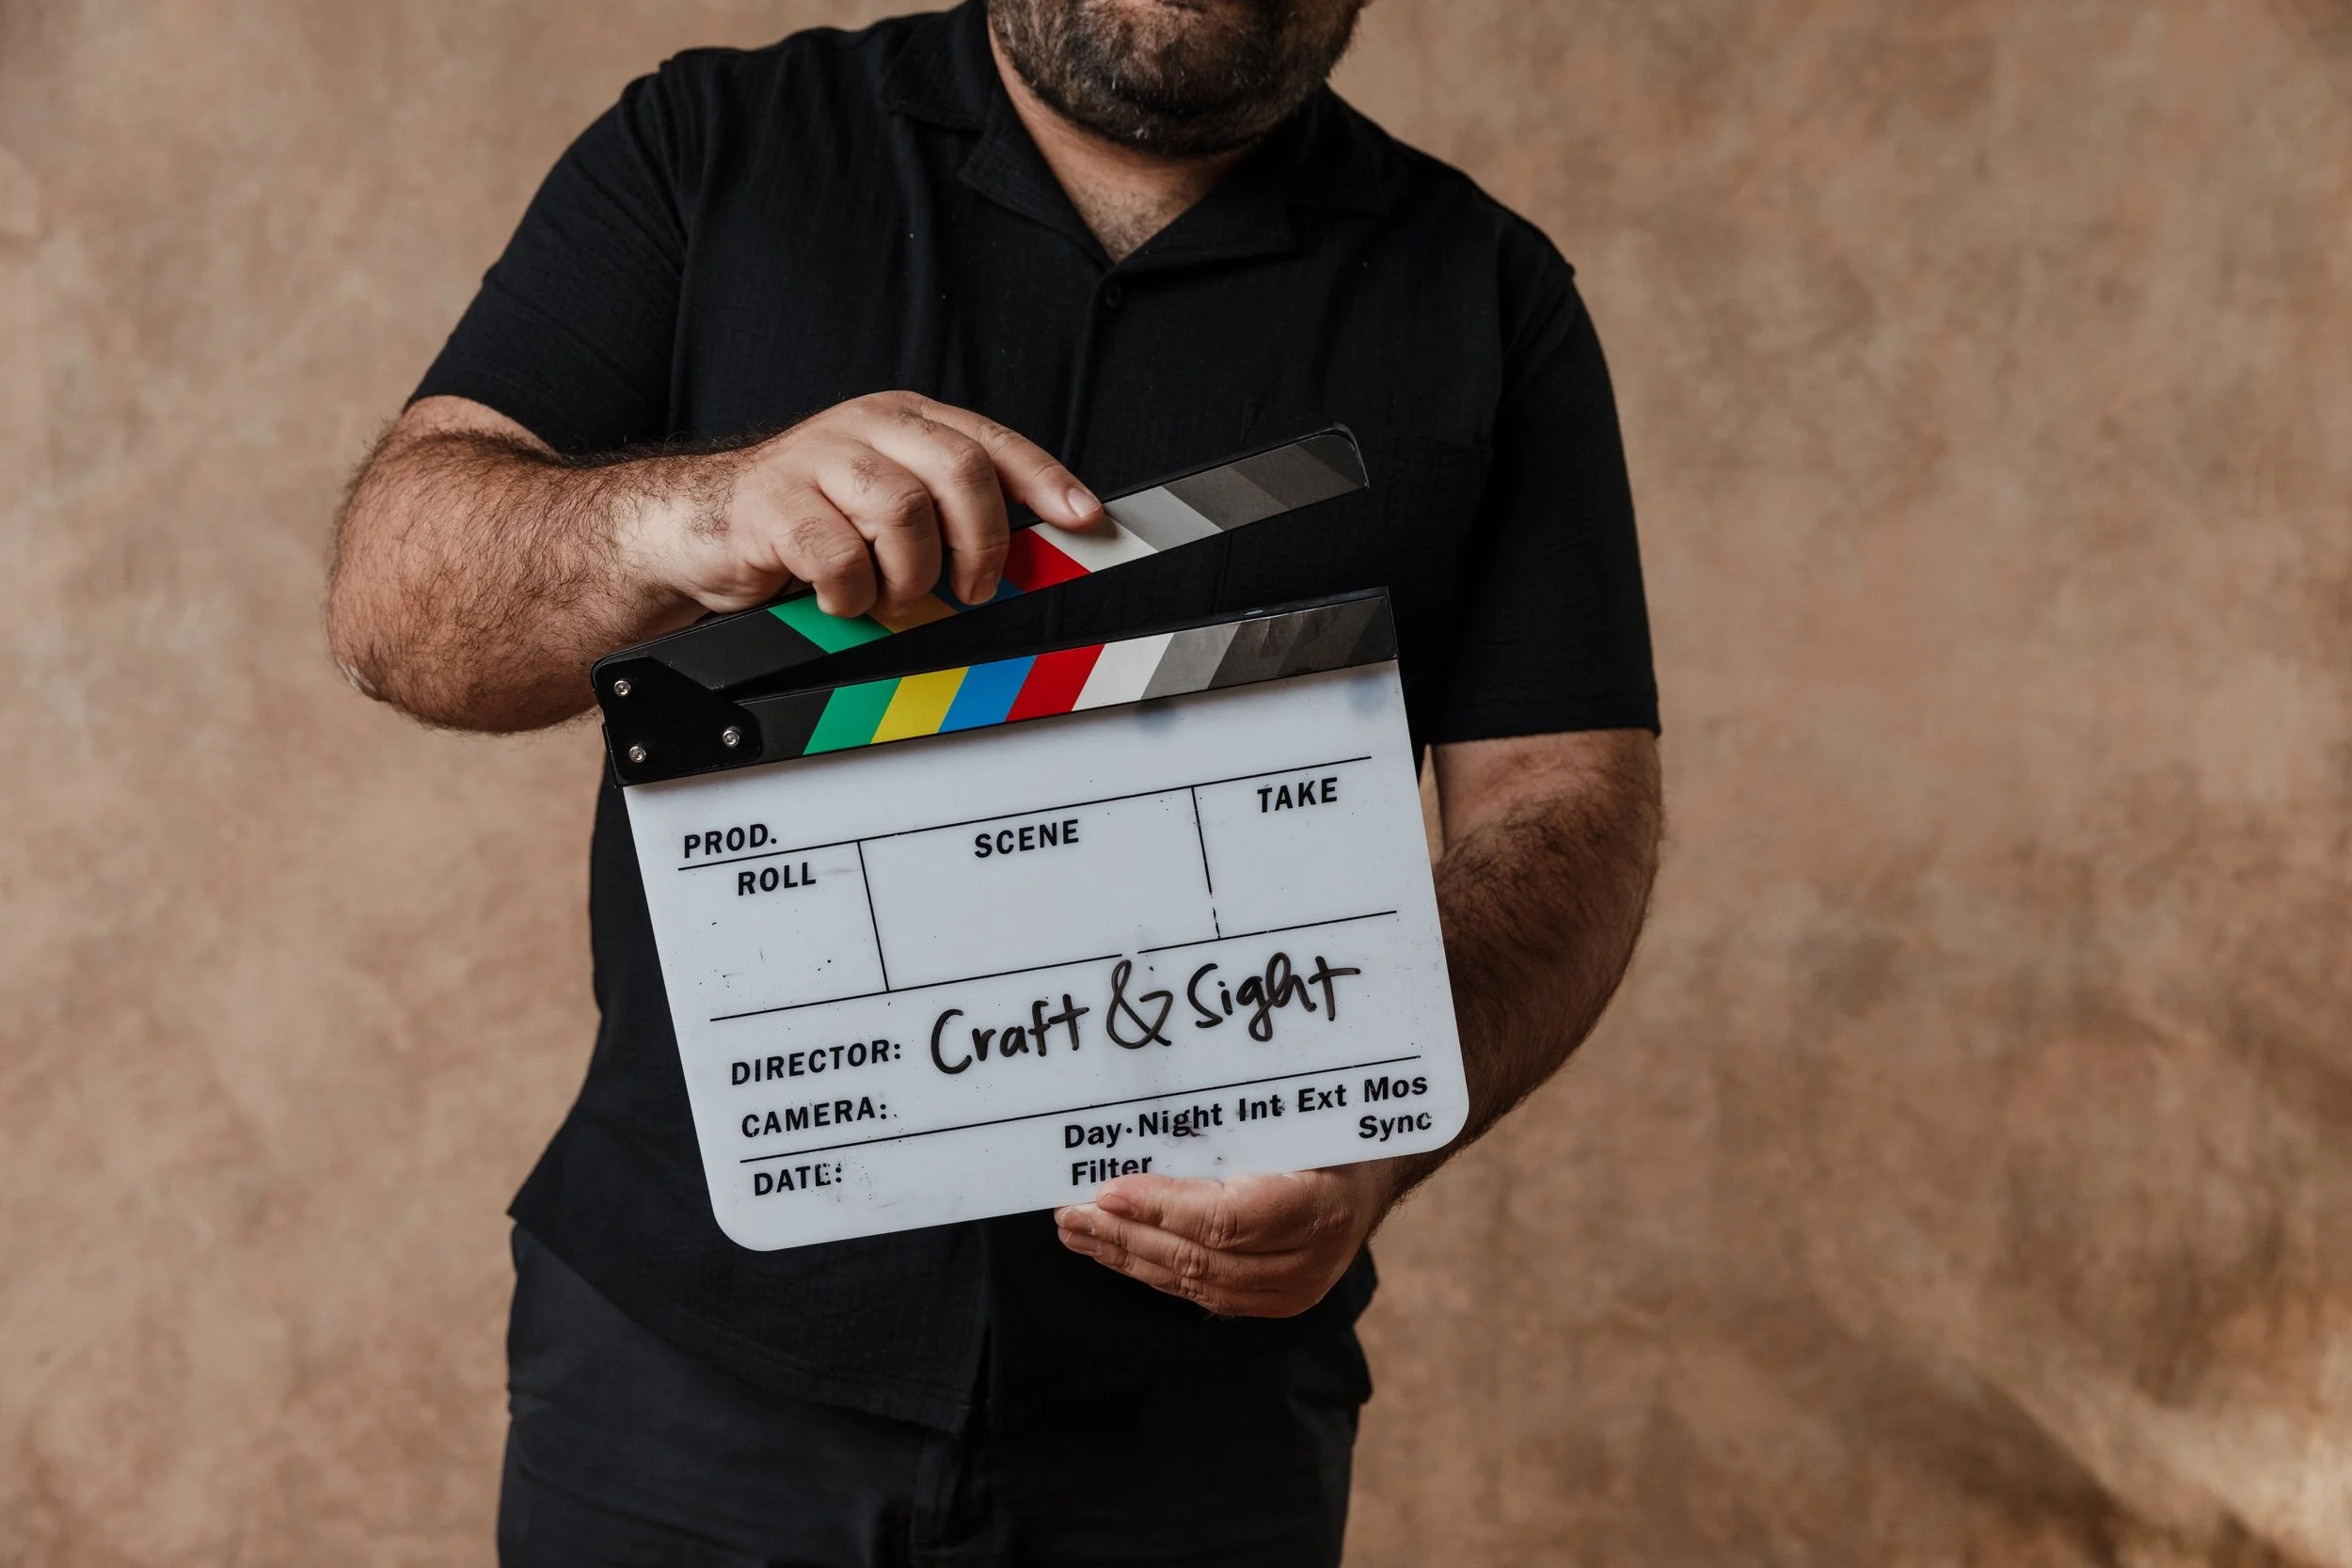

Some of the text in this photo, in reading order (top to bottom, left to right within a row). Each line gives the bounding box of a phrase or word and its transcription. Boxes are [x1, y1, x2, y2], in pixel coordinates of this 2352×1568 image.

[1257, 777, 1339, 814] TAKE
[683, 823, 777, 859] PROD.
[974, 818, 1080, 859] SCENE
[737, 862, 817, 896] ROLL
[930, 951, 1361, 1076] Craft & Sight
[731, 1038, 901, 1086] DIRECTOR:
[740, 1096, 887, 1138] CAMERA:
[1238, 1093, 1282, 1124] Int
[1297, 1083, 1347, 1113] Ext
[1363, 1075, 1428, 1103] Mos
[1358, 1111, 1433, 1143] Sync
[753, 1162, 842, 1196] DATE:
[1071, 1155, 1152, 1186] Filter
